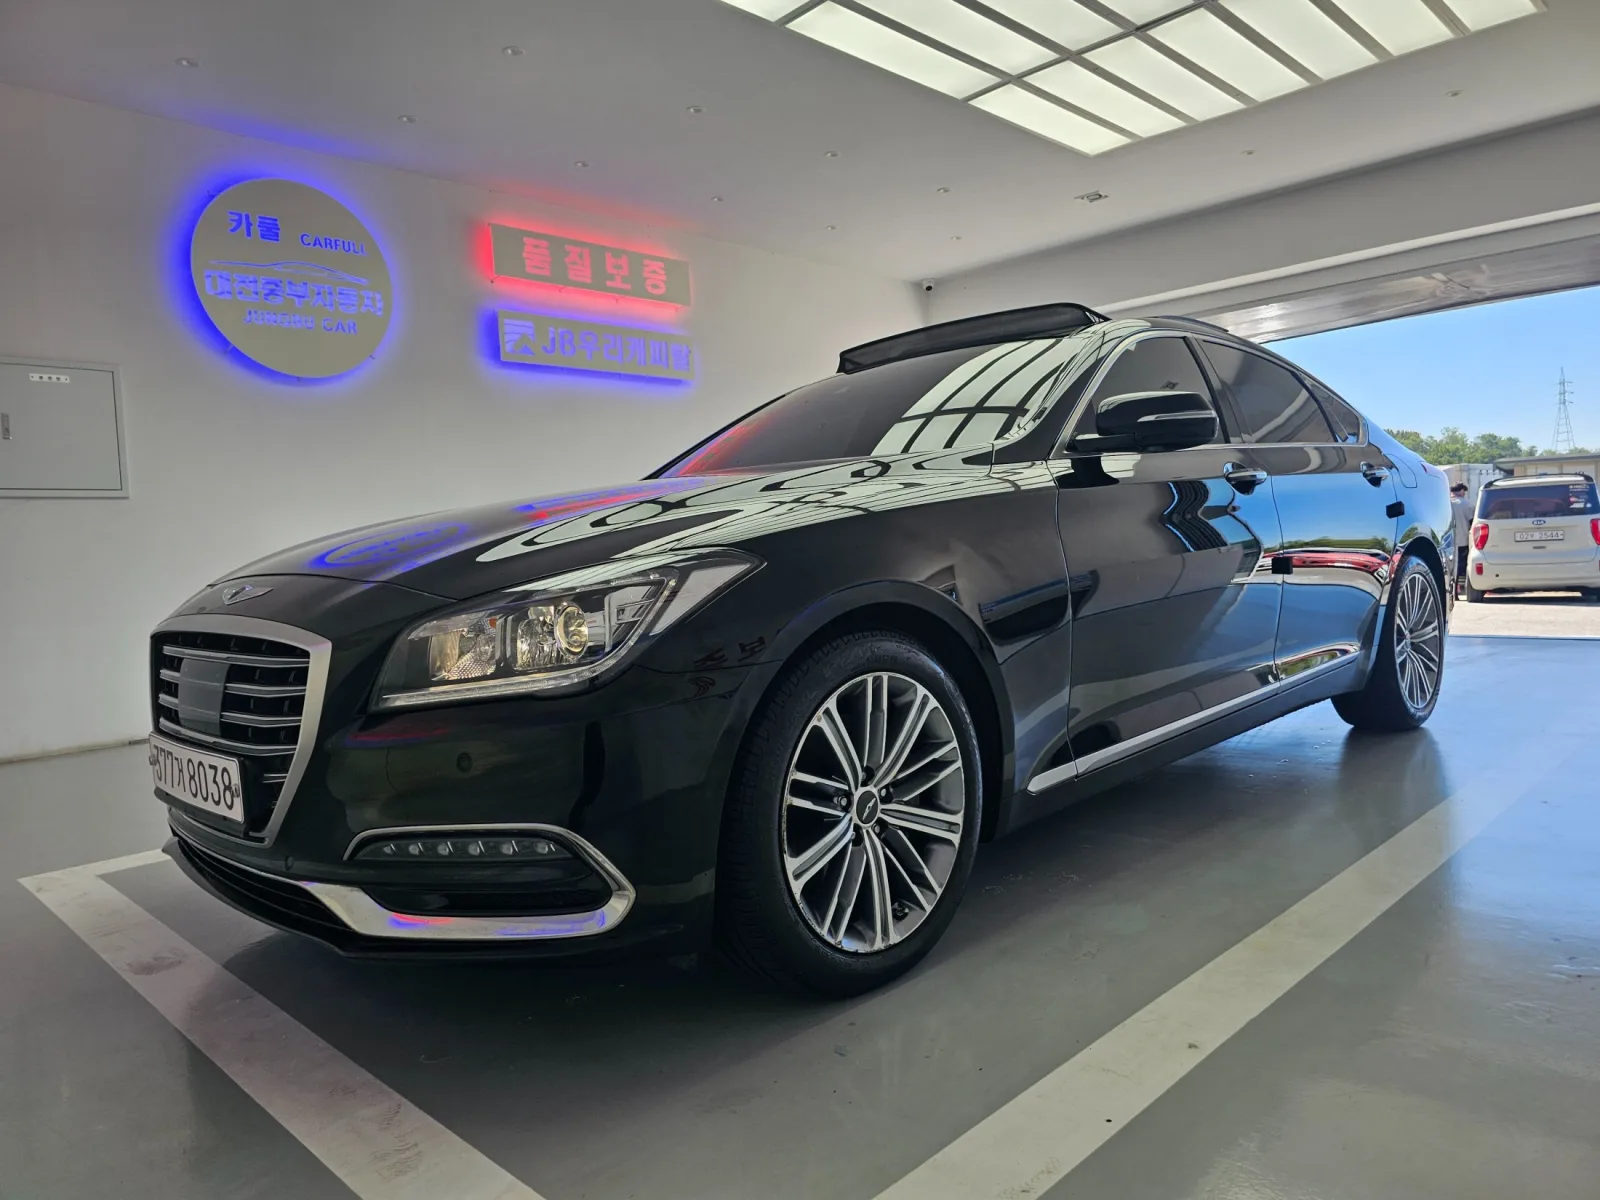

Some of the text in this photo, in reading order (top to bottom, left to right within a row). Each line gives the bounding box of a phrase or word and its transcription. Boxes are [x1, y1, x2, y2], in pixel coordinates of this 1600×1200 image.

[227, 210, 281, 243] 카풀
[522, 236, 667, 296] 품질보증
[322, 318, 358, 335] CAR
